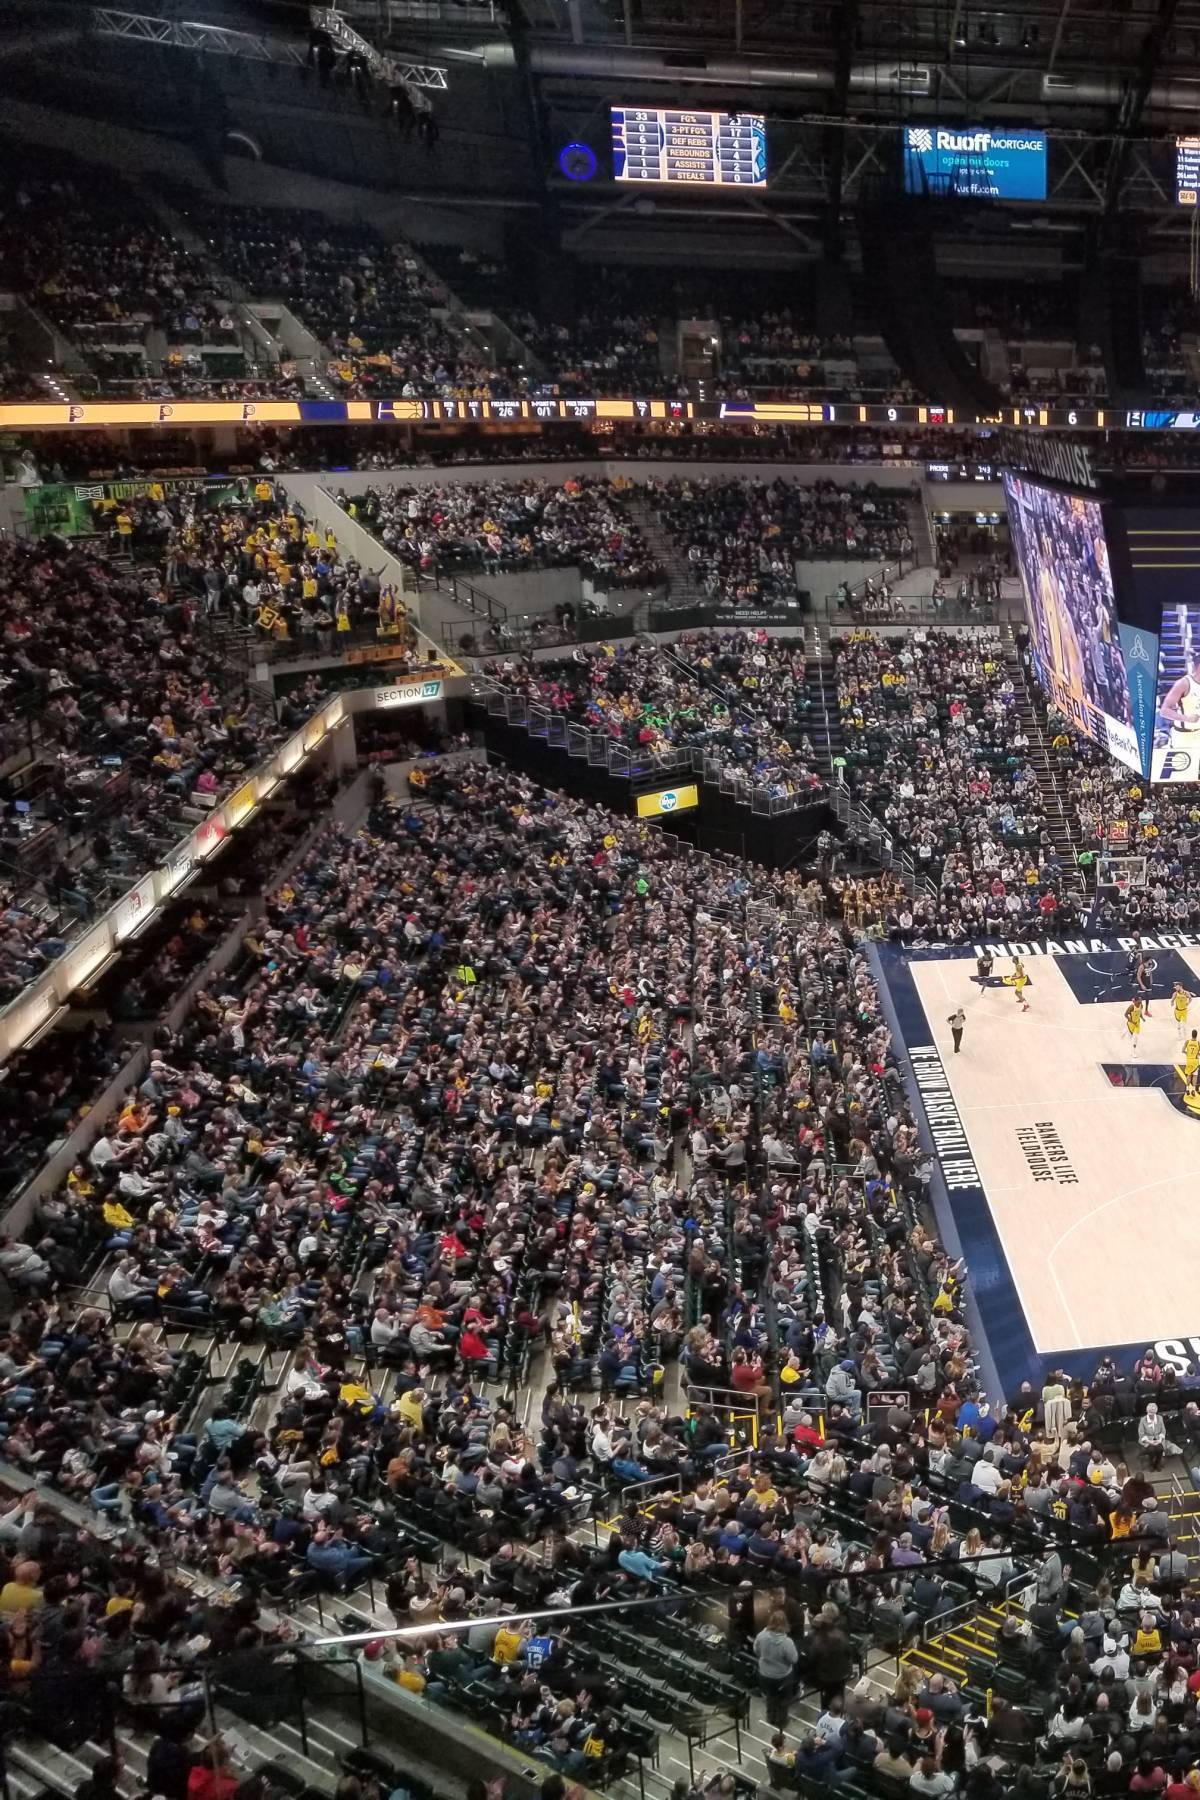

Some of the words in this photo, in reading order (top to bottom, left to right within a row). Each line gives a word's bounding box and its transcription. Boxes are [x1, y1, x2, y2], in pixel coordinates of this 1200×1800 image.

[635, 112, 648, 121] 33
[680, 115, 697, 123] FG%
[639, 124, 645, 132] 0
[671, 125, 689, 135] 3-PT
[689, 127, 707, 135] FG%
[730, 128, 742, 137] 17
[639, 135, 647, 144] 6
[672, 137, 686, 146] DEF
[688, 138, 707, 147] REBS
[733, 140, 740, 149] 4
[937, 131, 991, 152] Ruoff
[991, 140, 1043, 151] MORTGAGE
[640, 147, 646, 156] 7
[670, 148, 710, 158] REBOUNDS
[733, 151, 740, 160] 4
[641, 158, 647, 167] 1
[675, 161, 706, 169] ASSISTS
[734, 162, 741, 171] 2
[984, 156, 1010, 168] doors
[641, 169, 648, 178] 0
[677, 172, 705, 180] STEALS
[734, 174, 741, 182] 0
[446, 407, 452, 417] 7
[471, 407, 477, 417] 1
[499, 407, 513, 417] 2/6
[537, 407, 551, 416] 0/1
[574, 407, 589, 416] 2/3
[638, 407, 646, 417] 7
[673, 408, 680, 417] 2
[887, 408, 897, 421] 9
[1027, 415, 1032, 424] 1
[1068, 412, 1077, 425] 6
[376, 687, 421, 702] SECTION
[423, 684, 437, 695] 127
[1136, 671, 1145, 719] Ascension
[1112, 827, 1126, 838] 24
[973, 937, 1112, 958] INDIANA
[908, 1045, 939, 1060] WE
[912, 1060, 949, 1089] GROW
[921, 1090, 970, 1158] BASKETBALL
[1014, 1127, 1055, 1182] FIELDHOUSE
[1034, 1121, 1069, 1162] BANKERS
[1053, 1164, 1079, 1185] LIFE
[940, 1158, 982, 1191] HERE
